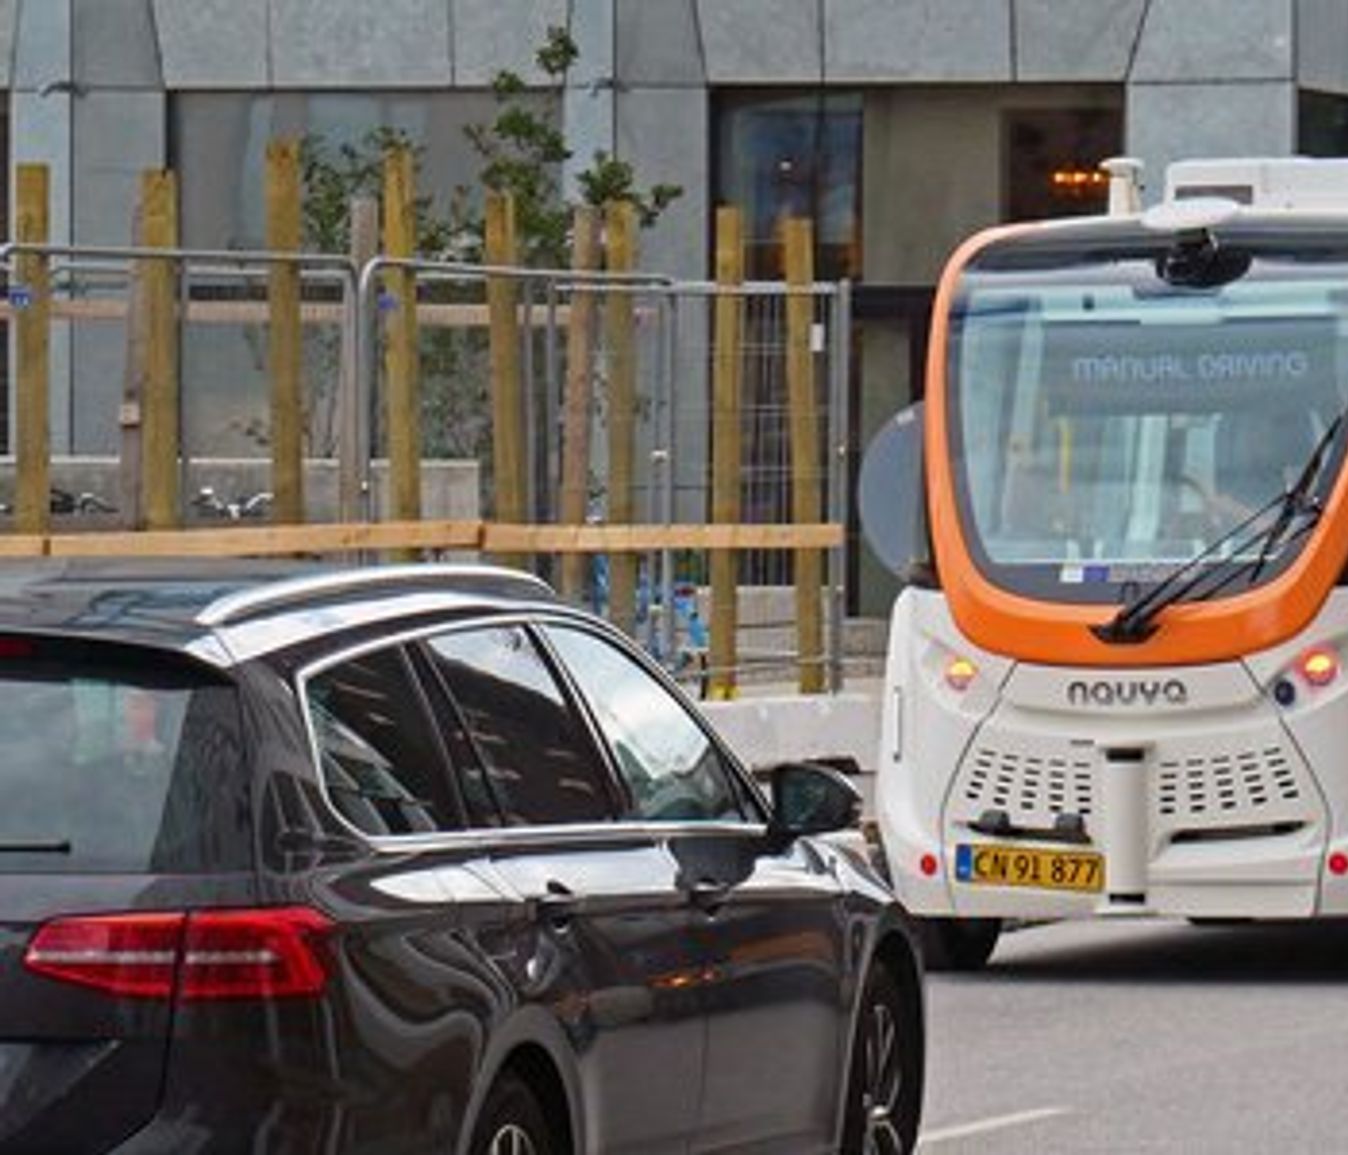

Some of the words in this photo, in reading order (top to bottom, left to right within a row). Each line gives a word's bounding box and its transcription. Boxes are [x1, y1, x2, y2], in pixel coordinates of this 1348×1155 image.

[1073, 355, 1194, 382] MANUAL
[1198, 351, 1307, 378] DRIVING
[974, 850, 1010, 879] CN
[1013, 854, 1041, 880] 91
[1051, 857, 1100, 884] 877
